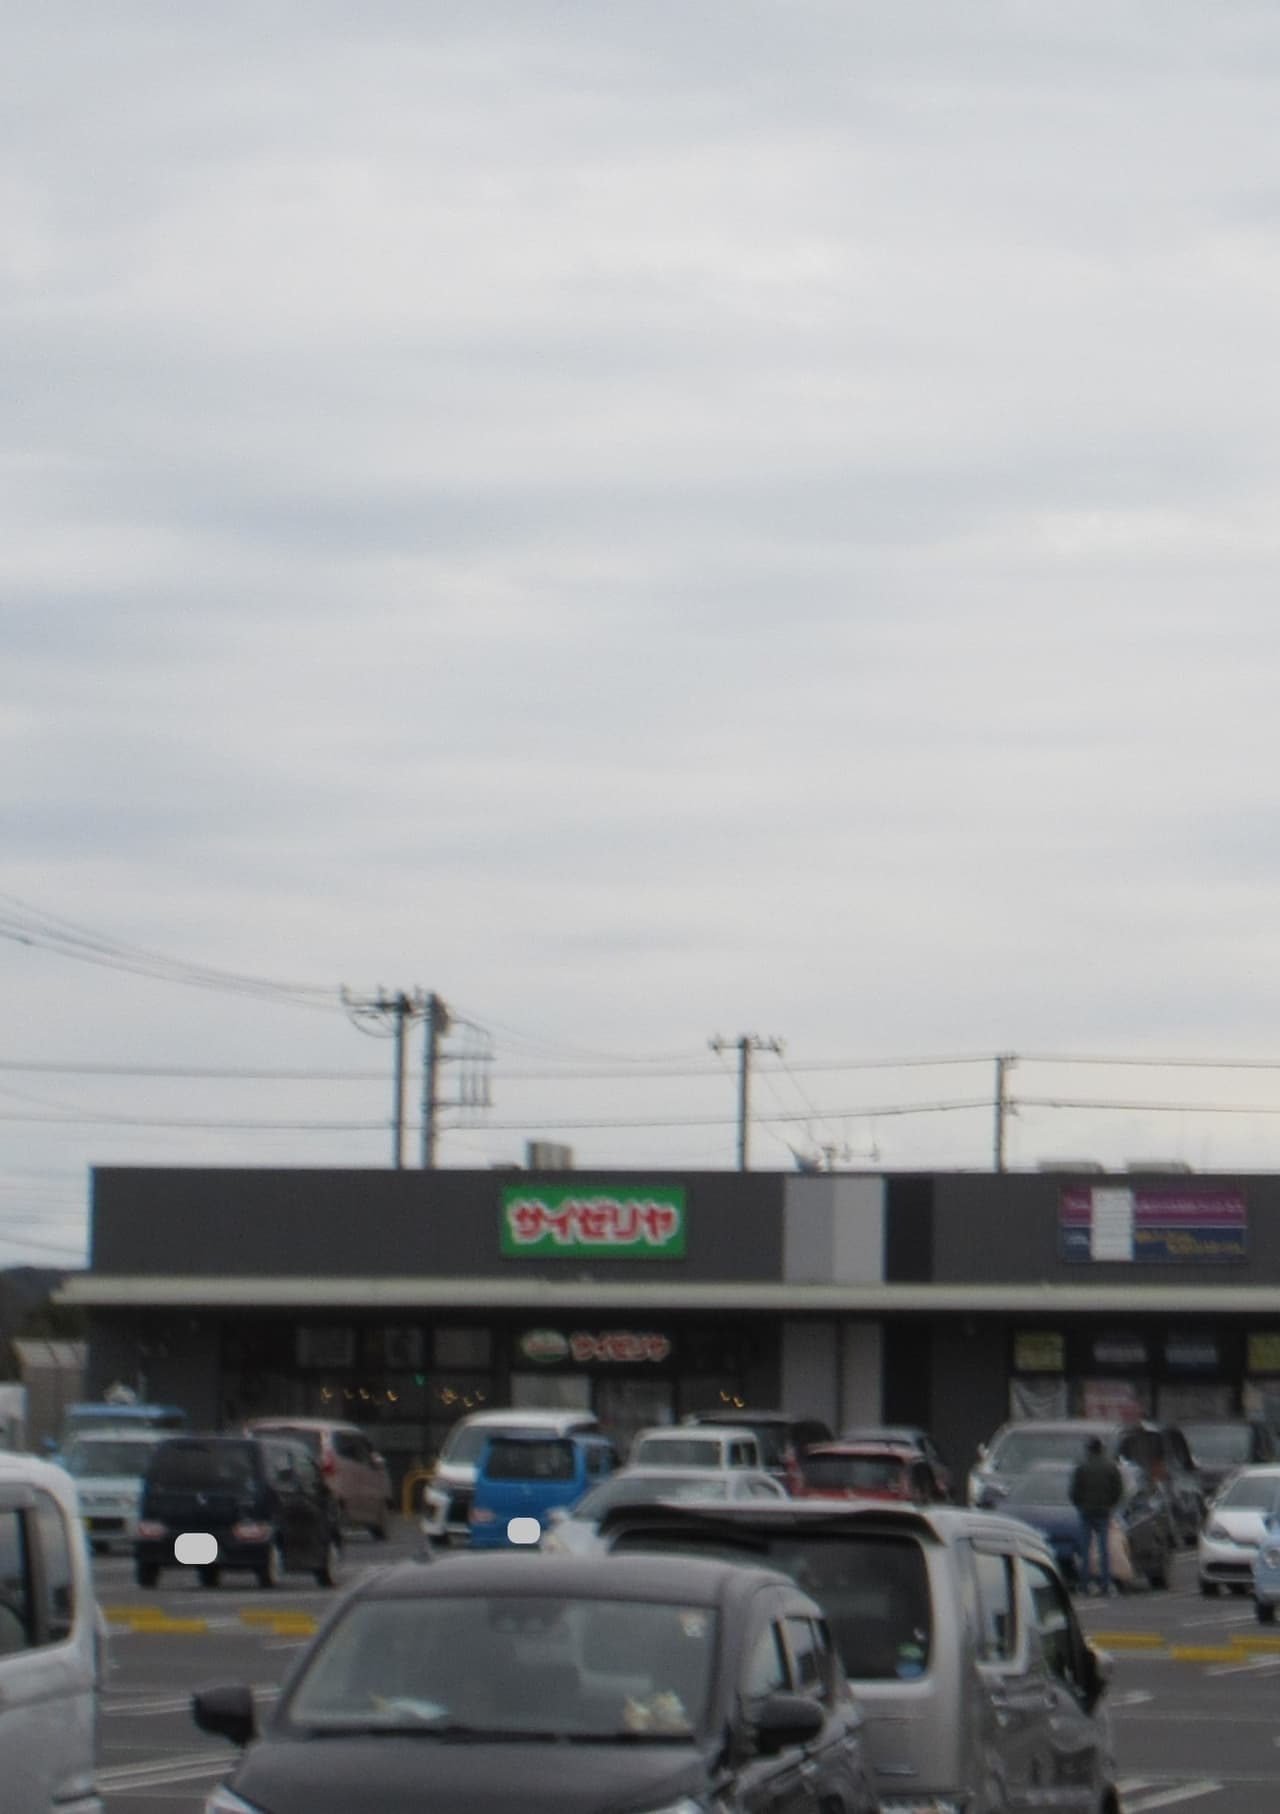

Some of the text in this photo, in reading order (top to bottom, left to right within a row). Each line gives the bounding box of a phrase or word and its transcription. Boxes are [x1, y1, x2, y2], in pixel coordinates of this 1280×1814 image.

[508, 1198, 677, 1245] サイゼリヤ
[570, 1330, 671, 1361] サイゼリヤ
